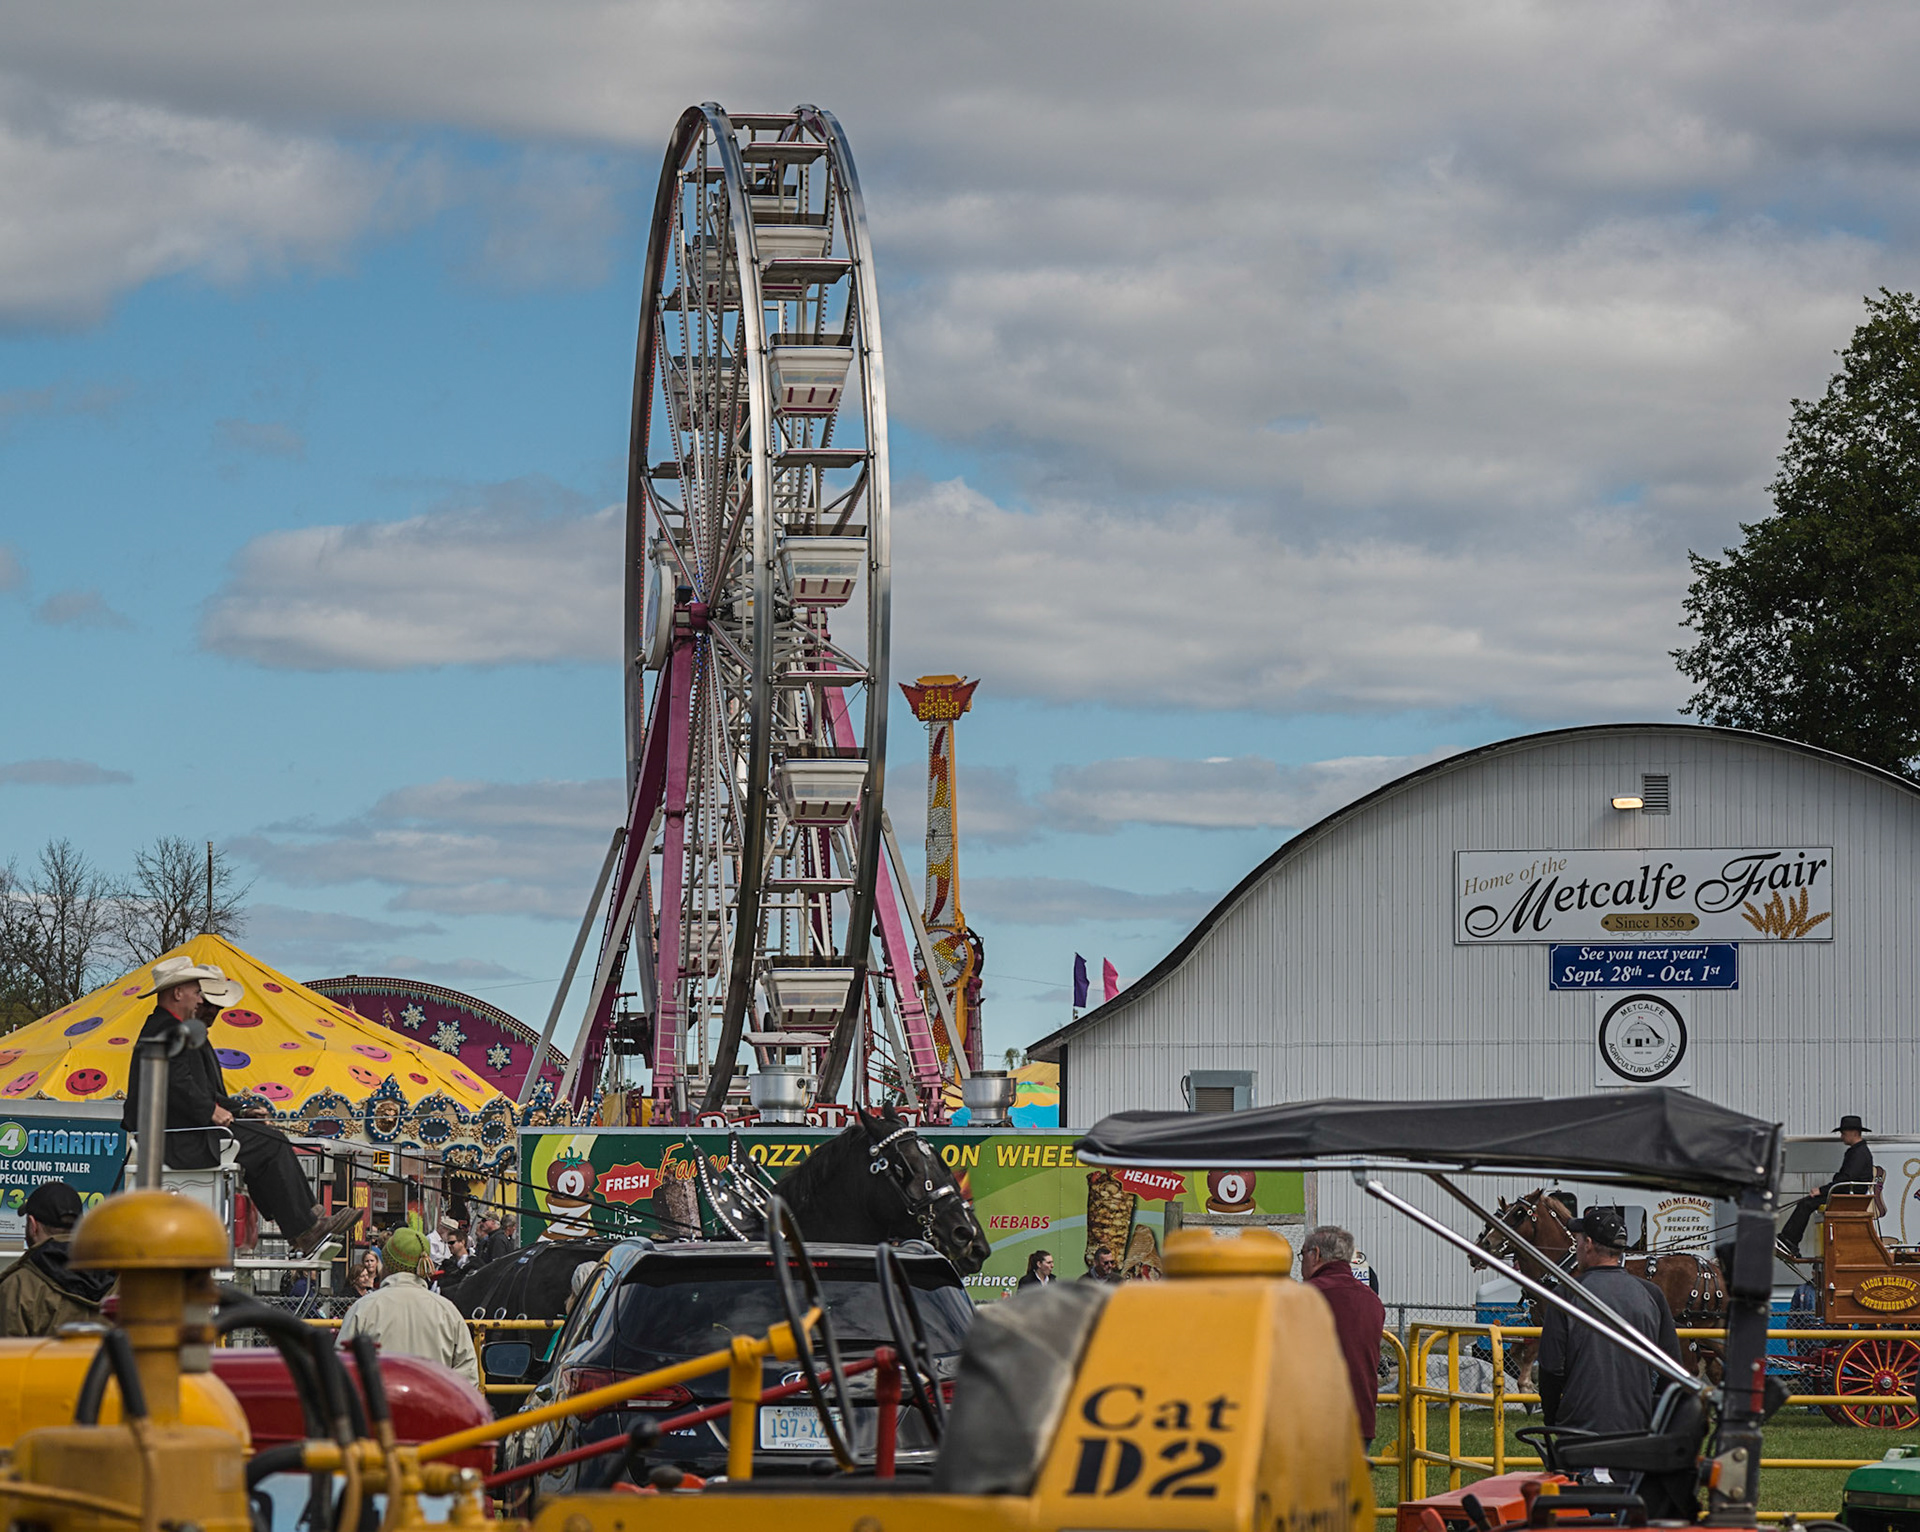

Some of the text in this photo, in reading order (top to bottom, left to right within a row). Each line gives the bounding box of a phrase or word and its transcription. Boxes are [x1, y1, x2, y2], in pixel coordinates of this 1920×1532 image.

[925, 689, 952, 702] ALI
[919, 702, 959, 719] BABA
[1464, 856, 1568, 897] Home of the
[1465, 852, 1827, 938] Metcalfe Fair
[1615, 916, 1685, 929] Since 1856
[1579, 946, 1709, 964] See you next year!
[1562, 965, 1605, 987] Sept.
[1610, 965, 1642, 982] 28th
[1659, 965, 1694, 982] Oct.
[1701, 965, 1720, 982] 1st
[1620, 1003, 1665, 1017] METCALFE
[1608, 1042, 1677, 1073] AGRICULTURAL SOCIETY
[28, 1129, 119, 1156] CHARITY
[12, 1160, 52, 1172] COOLING
[54, 1162, 90, 1173] TRAILER
[657, 1143, 729, 1181] Faou
[941, 1145, 980, 1167] ON
[605, 1174, 650, 1192] FRESH
[1123, 1170, 1182, 1191] HEALTHY
[1658, 1196, 1713, 1211] HOMEMADE
[989, 1214, 1050, 1229] KEBABS
[1861, 1276, 1917, 1291] NICOL BELGIANS
[1081, 1382, 1240, 1432] Cat
[771, 1419, 798, 1438] 197
[1066, 1437, 1226, 1498] D2
